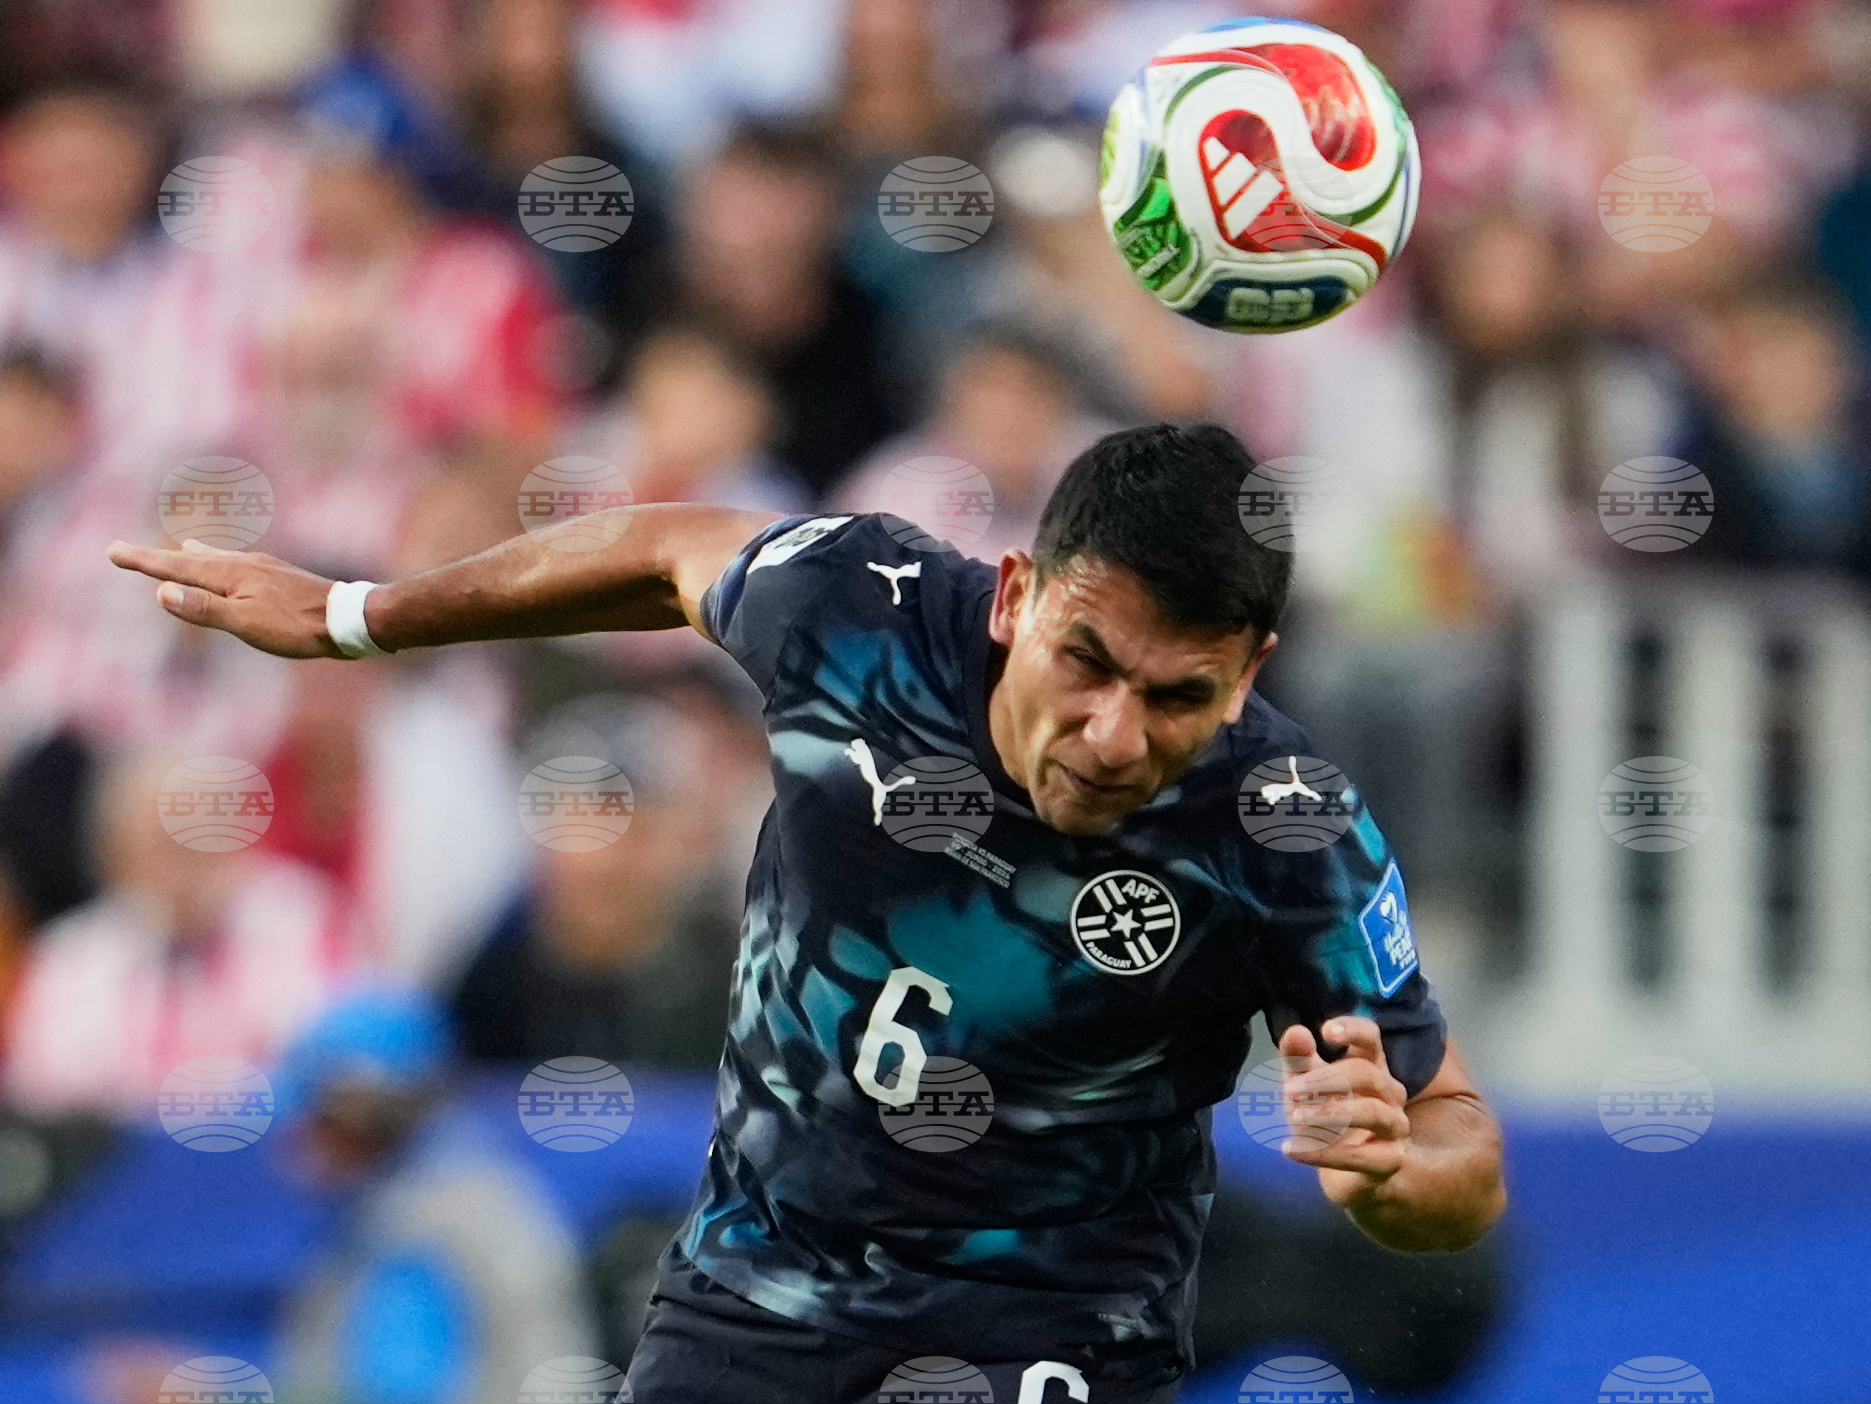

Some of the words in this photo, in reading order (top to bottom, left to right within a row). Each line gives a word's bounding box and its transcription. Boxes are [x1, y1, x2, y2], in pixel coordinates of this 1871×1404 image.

[1121, 878, 1160, 904] APF
[1085, 941, 1132, 968] PARAGUAY
[853, 966, 953, 1106] 6
